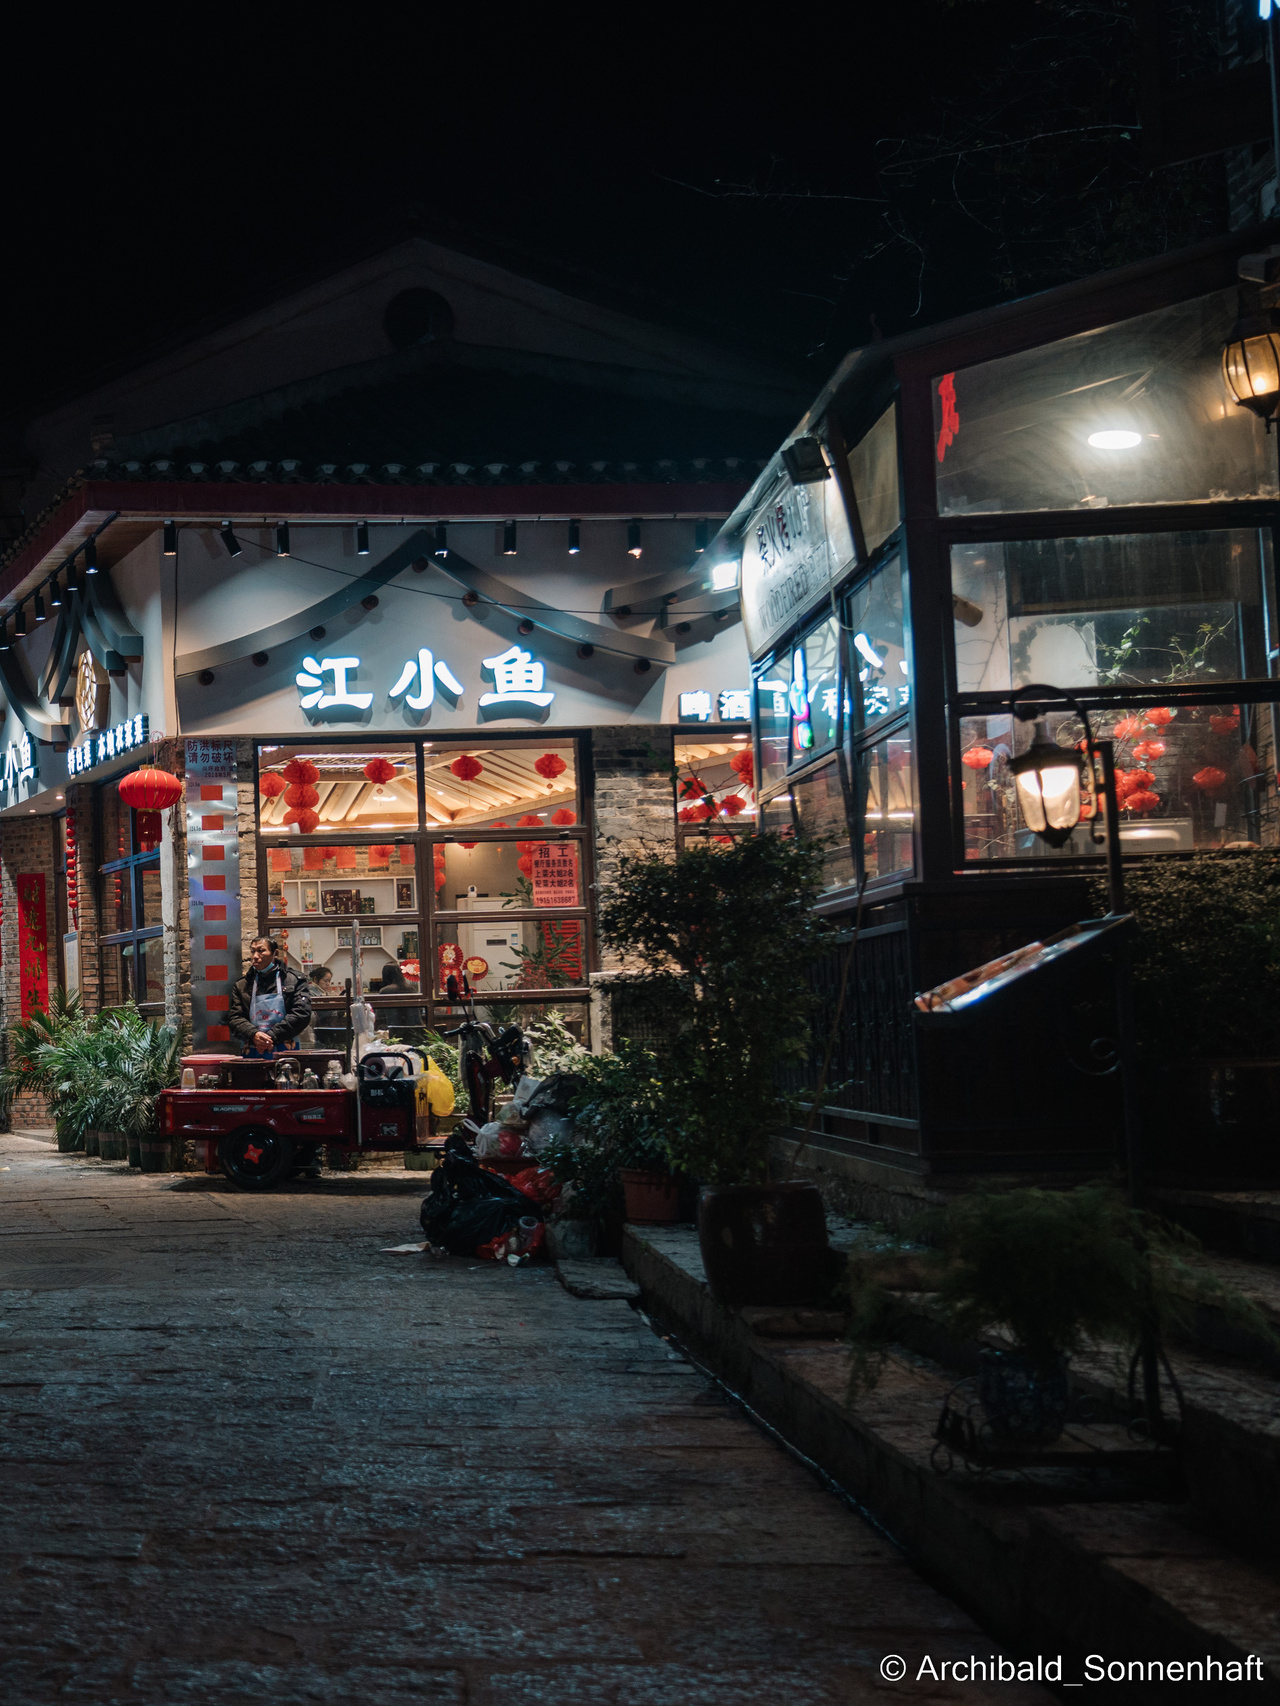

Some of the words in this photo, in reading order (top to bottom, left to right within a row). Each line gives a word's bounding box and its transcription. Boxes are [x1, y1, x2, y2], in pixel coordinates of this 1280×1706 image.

[296, 646, 555, 710] 江小鱼
[187, 740, 233, 752] 防洪标尺
[187, 752, 234, 764] 请勿破坏
